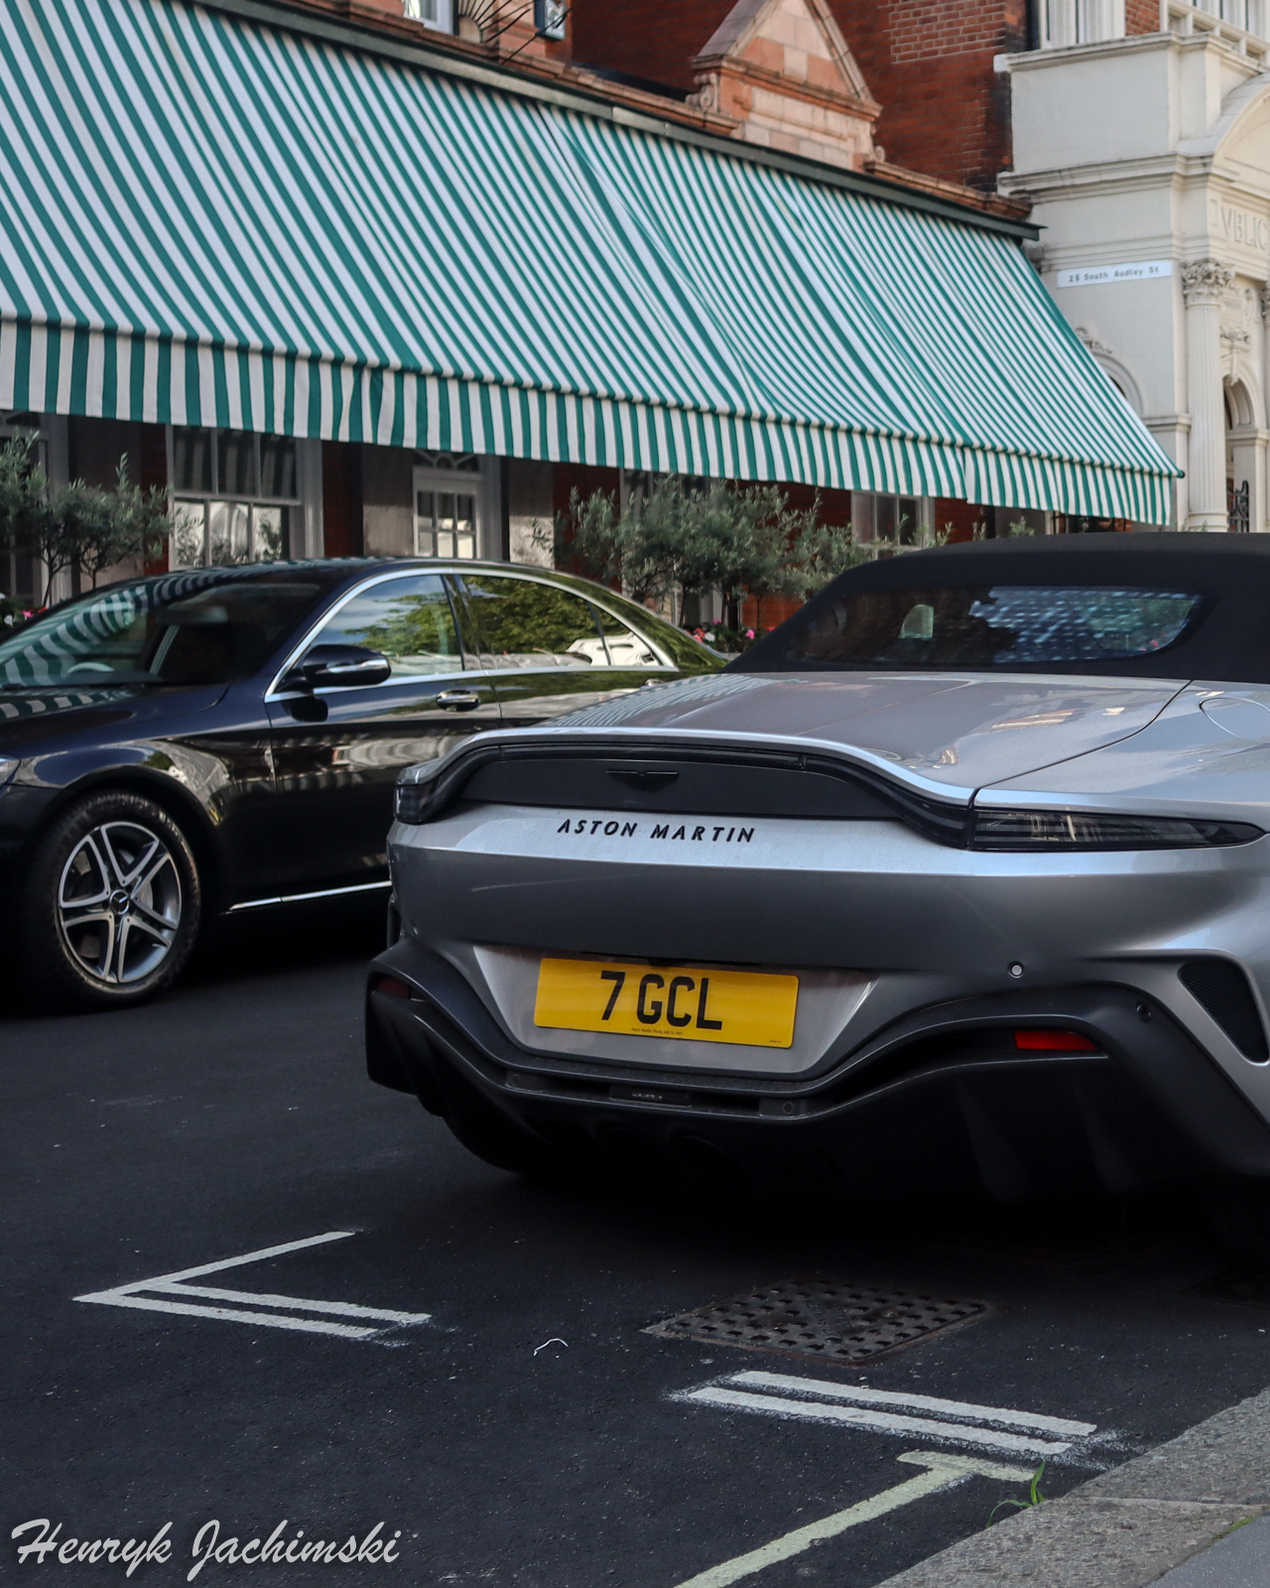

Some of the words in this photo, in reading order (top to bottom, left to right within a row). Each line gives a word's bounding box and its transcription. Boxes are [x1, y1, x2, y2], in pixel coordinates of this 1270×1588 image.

[1069, 274, 1080, 282] 25
[1084, 272, 1108, 281] South
[1113, 268, 1143, 278] Audley
[1149, 266, 1159, 274] St
[557, 819, 638, 837] ASTON
[650, 824, 755, 843] MARTIN
[600, 970, 626, 1021] 7
[636, 973, 723, 1031] GCL
